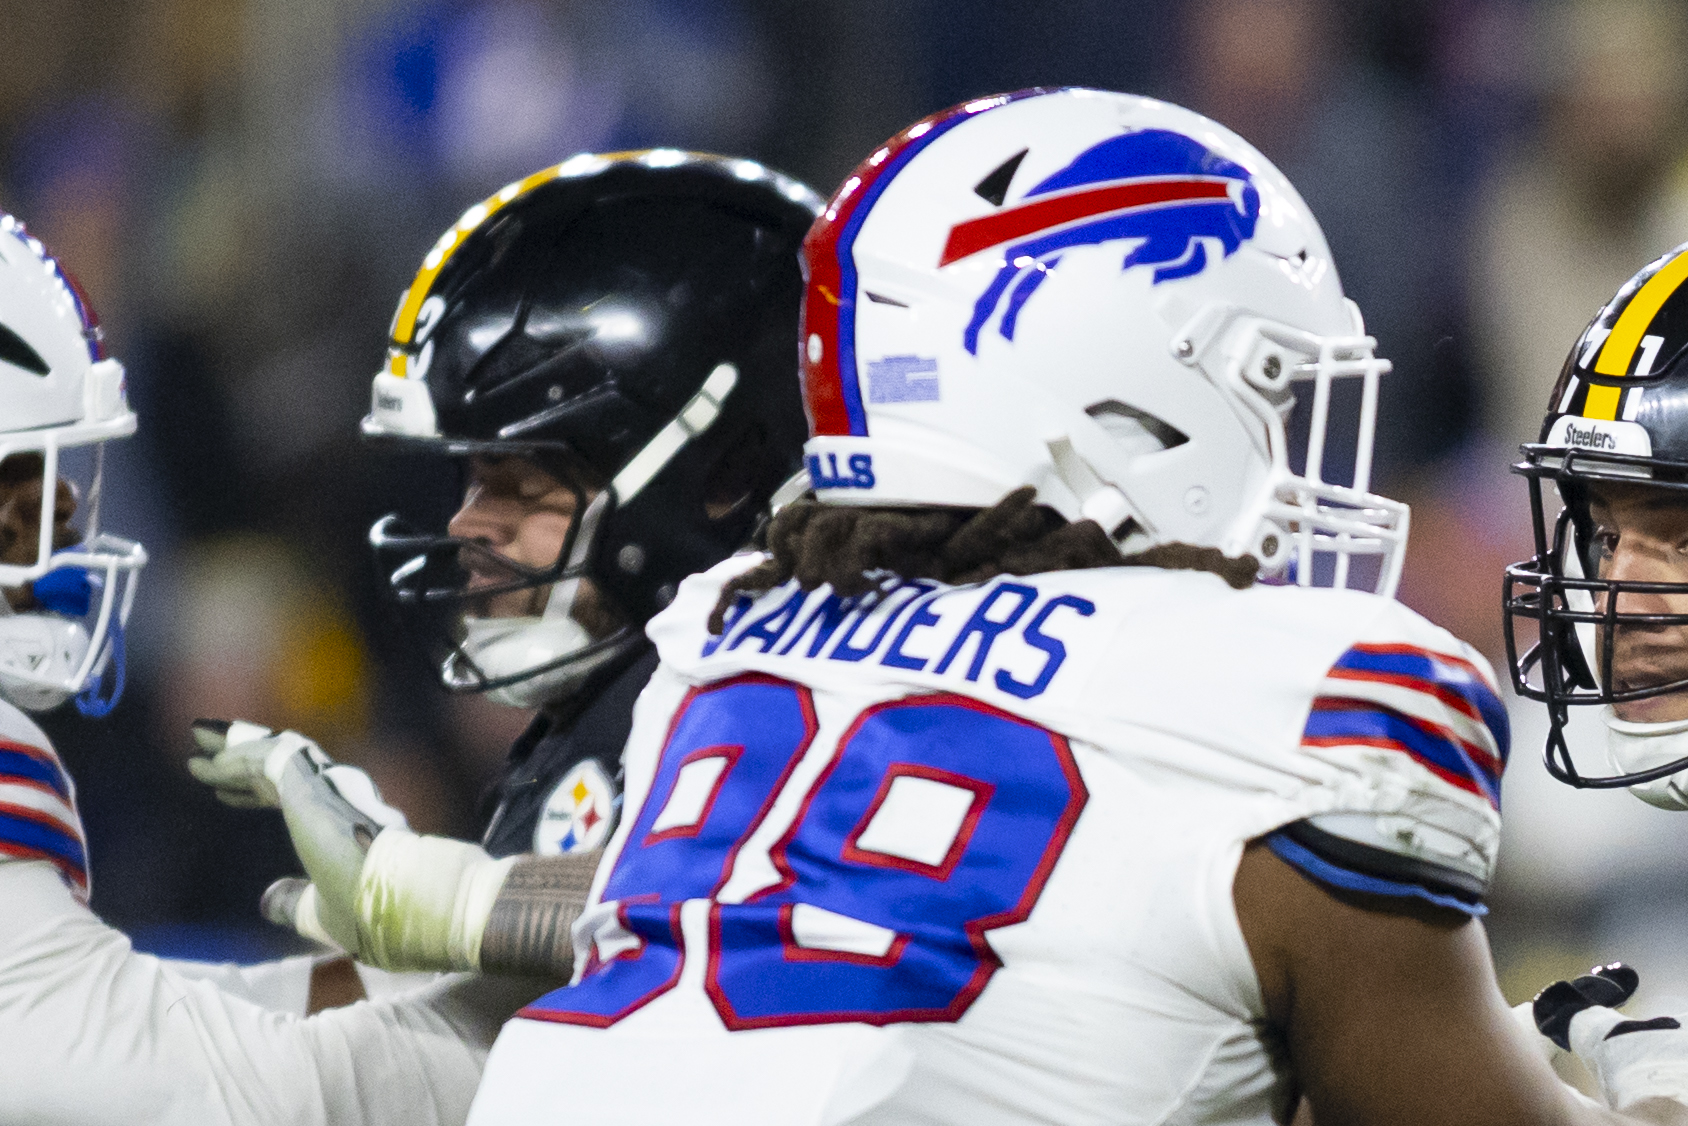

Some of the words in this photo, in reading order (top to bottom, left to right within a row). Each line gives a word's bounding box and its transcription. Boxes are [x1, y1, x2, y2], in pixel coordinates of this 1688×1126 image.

[1564, 422, 1617, 450] Steelers
[803, 452, 876, 490] LLS
[510, 670, 1091, 1032] 98
